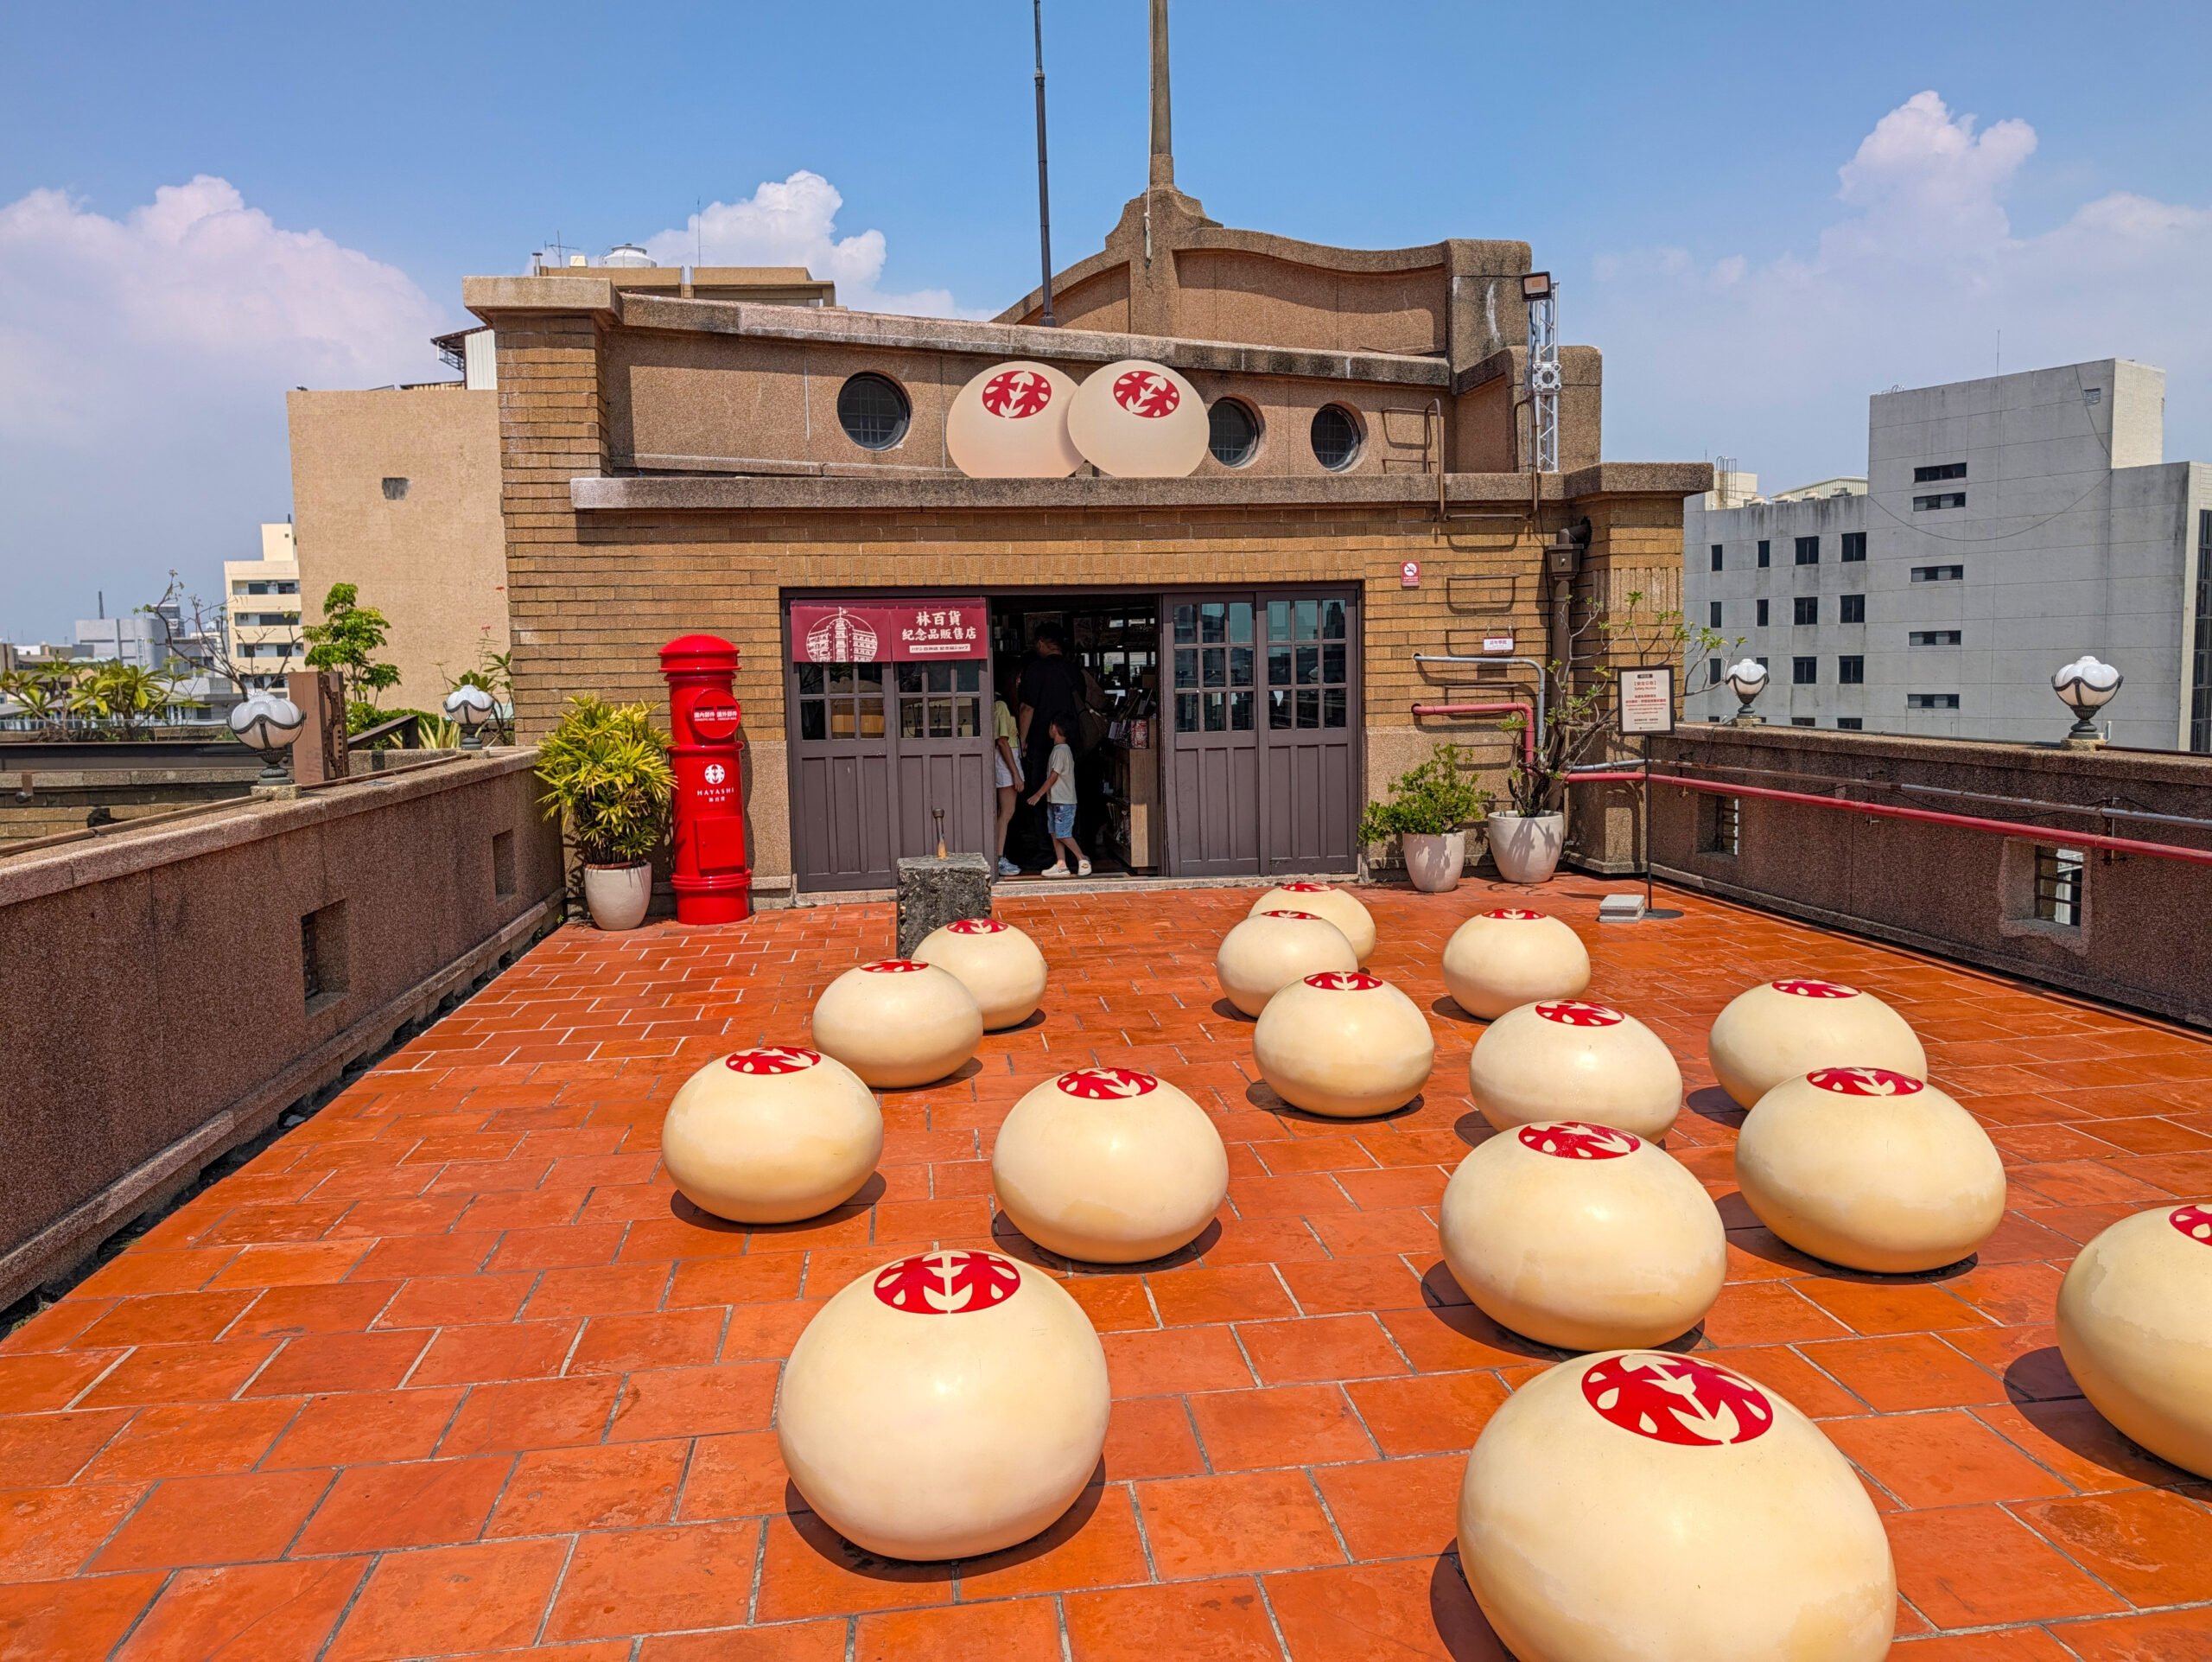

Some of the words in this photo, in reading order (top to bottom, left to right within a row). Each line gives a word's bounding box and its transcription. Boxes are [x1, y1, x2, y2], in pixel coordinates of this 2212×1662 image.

[916, 610, 962, 627] 林百貨
[901, 627, 976, 641] 紀念品販售店
[696, 787, 734, 796] HAYASHI
